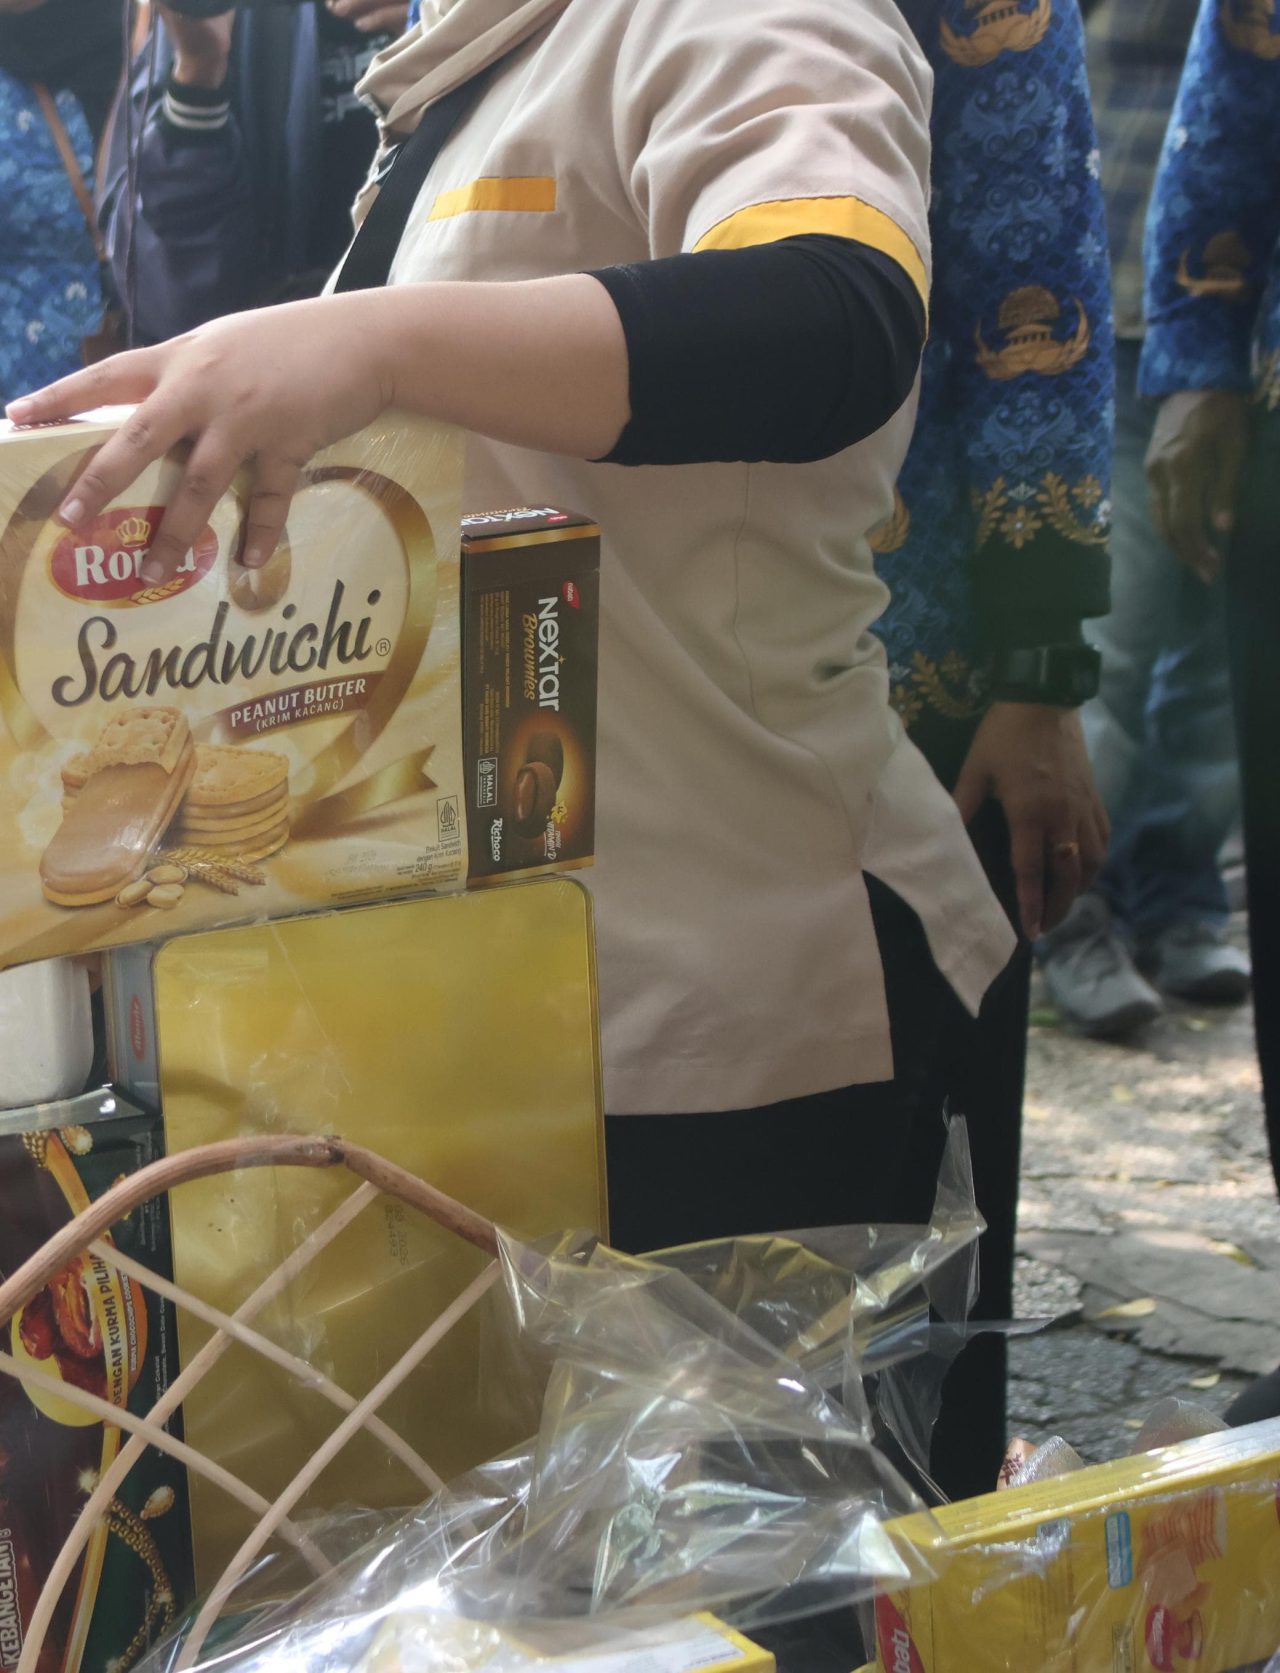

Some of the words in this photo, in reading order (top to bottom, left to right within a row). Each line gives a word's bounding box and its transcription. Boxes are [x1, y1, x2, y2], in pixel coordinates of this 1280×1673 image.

[51, 579, 381, 708] Sandwichi
[523, 613, 538, 701] Brownies
[231, 691, 300, 728] PEANUT
[304, 678, 367, 704] BUTTER
[256, 712, 291, 732] (KRIM
[295, 699, 344, 720] KACANG)
[486, 774, 494, 804] HALAL
[491, 817, 504, 861] Richoco
[546, 820, 556, 851] VITAMIN
[89, 1252, 114, 1294] PILIHA
[102, 1295, 121, 1346] KURMA
[109, 1347, 124, 1404] DENGAN
